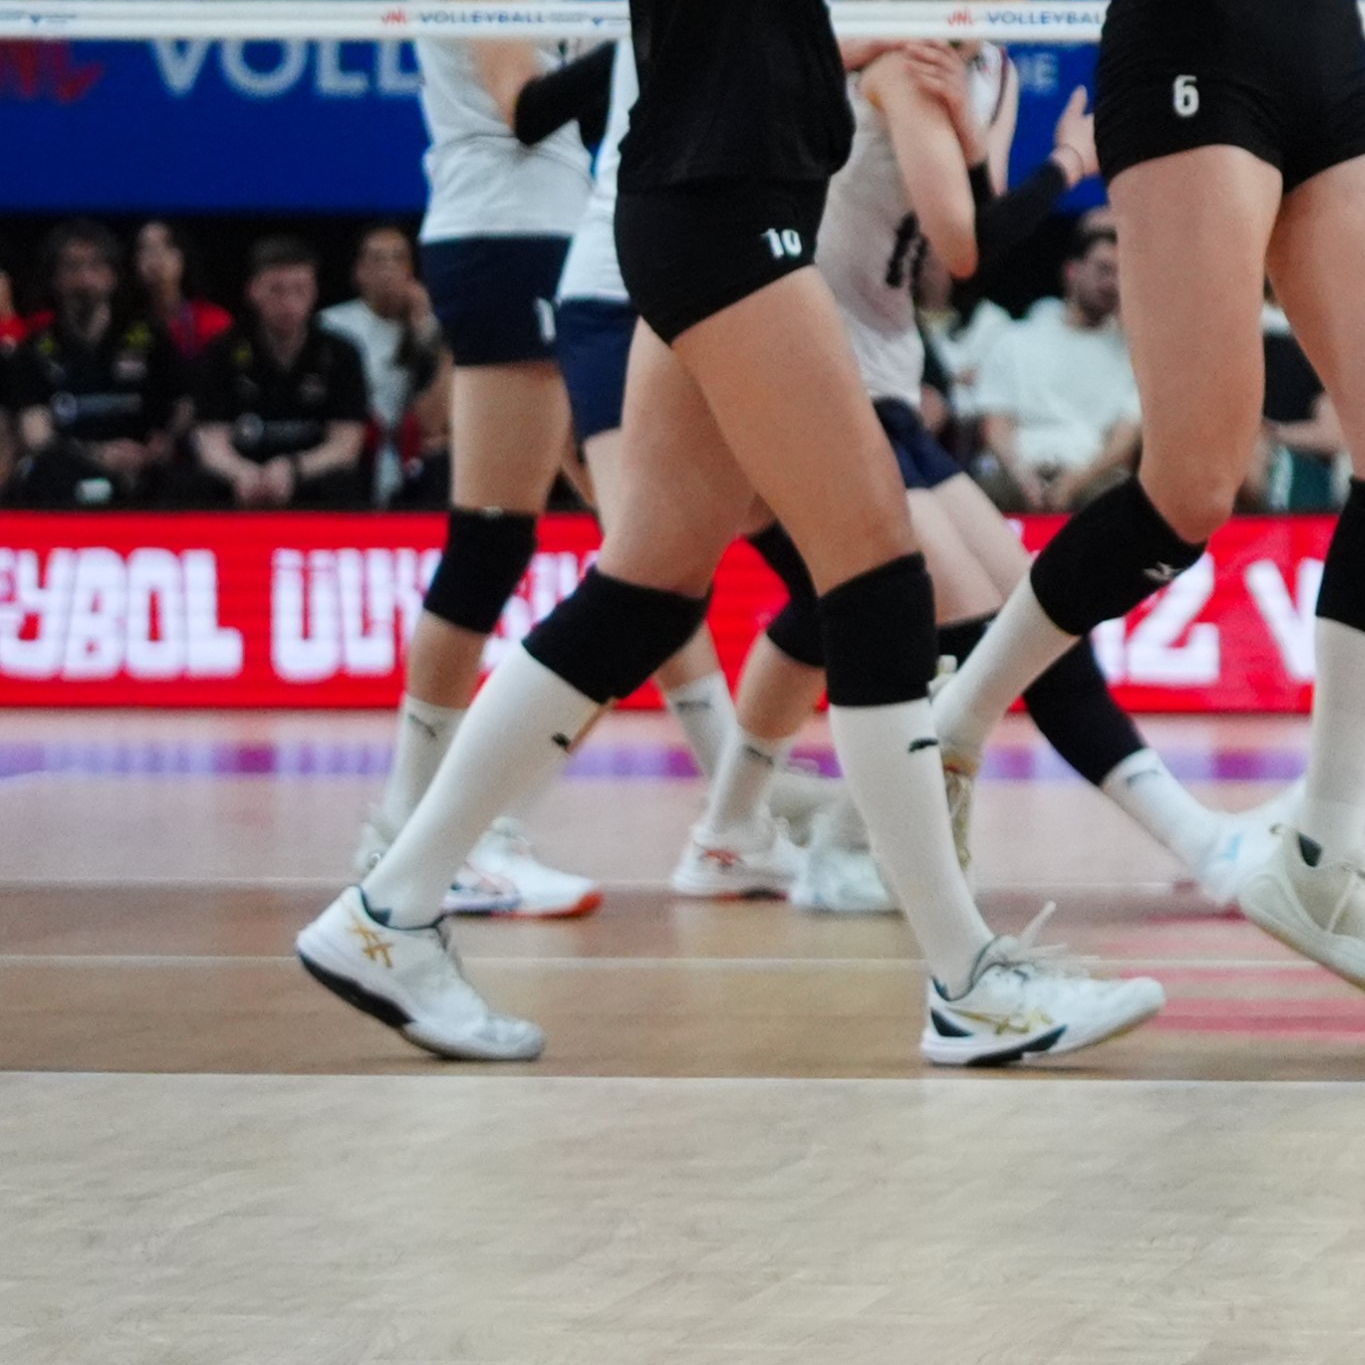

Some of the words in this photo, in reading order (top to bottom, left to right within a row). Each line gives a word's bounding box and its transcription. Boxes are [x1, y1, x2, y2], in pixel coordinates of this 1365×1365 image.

[419, 9, 546, 25] VOLLEYBALL
[1173, 74, 1200, 117] 6
[763, 228, 801, 259] 10
